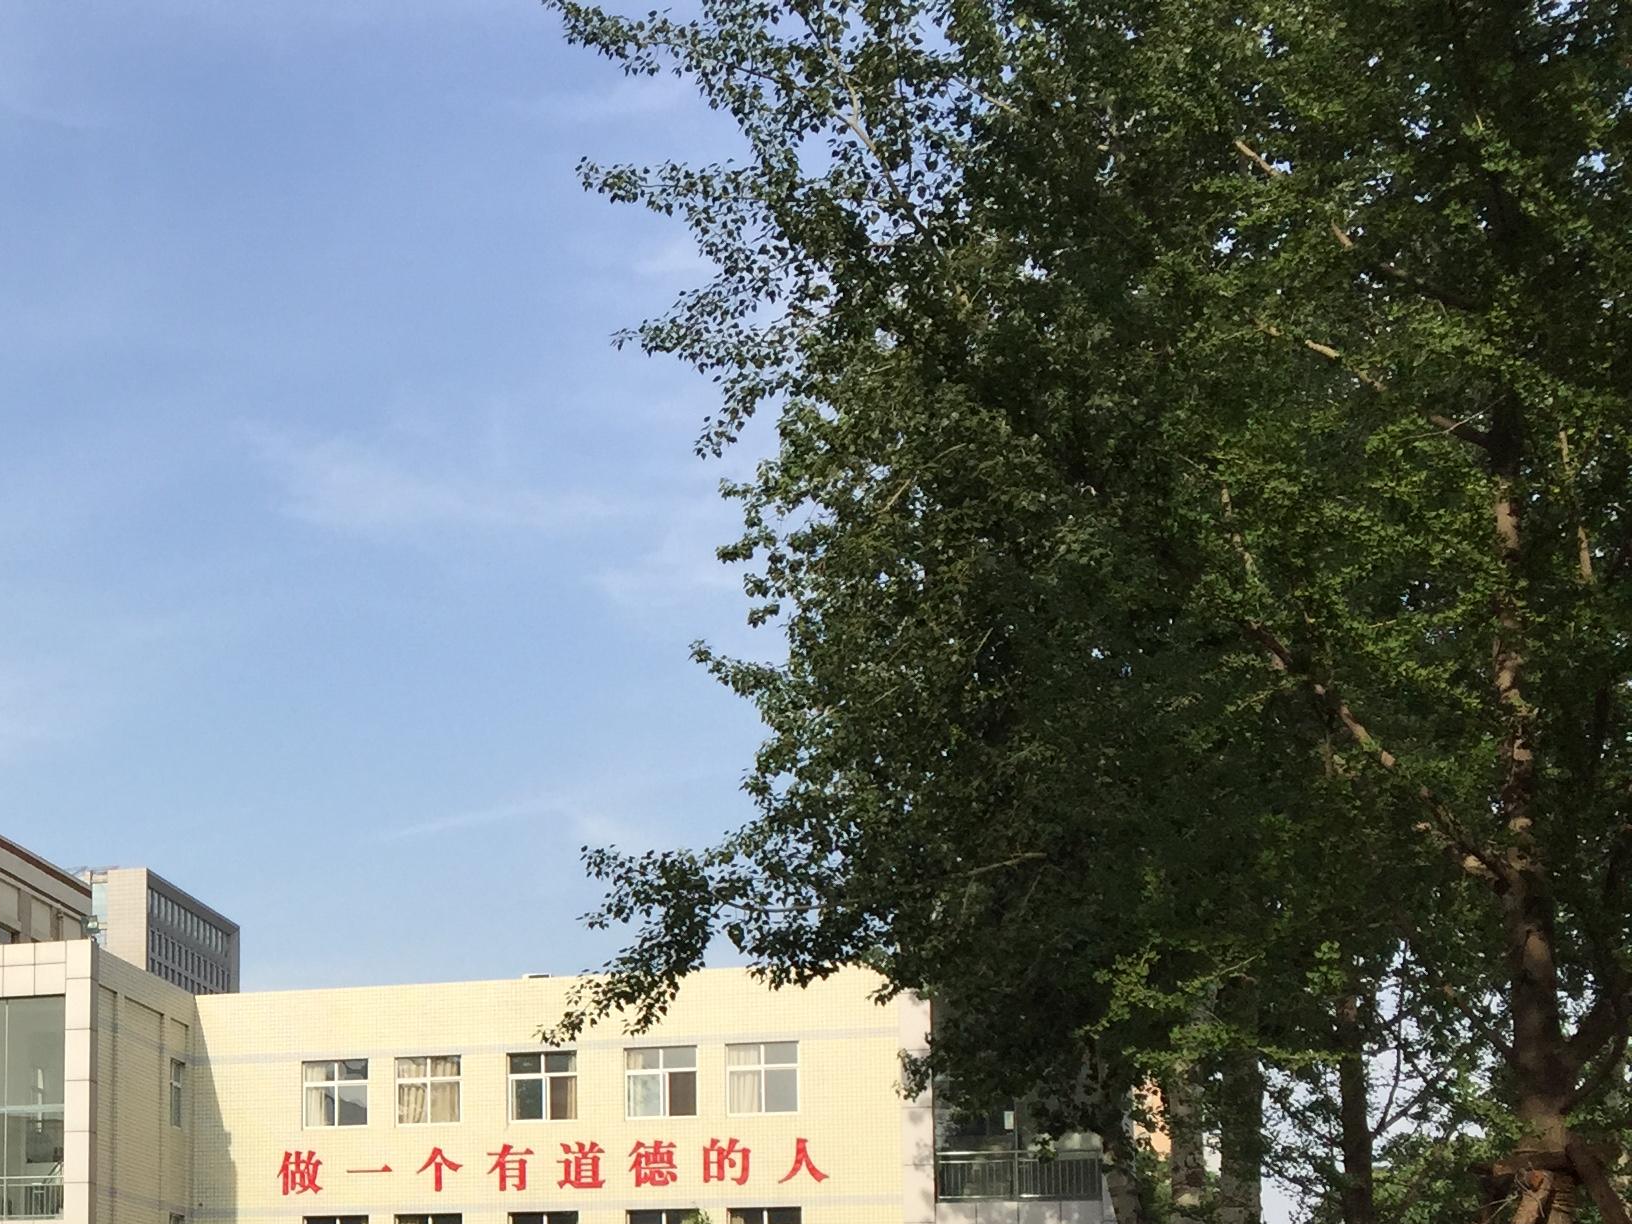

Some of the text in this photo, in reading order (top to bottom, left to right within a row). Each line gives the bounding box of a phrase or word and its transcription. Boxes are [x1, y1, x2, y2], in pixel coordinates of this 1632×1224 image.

[277, 1136, 829, 1196] 做一个有道德的人
